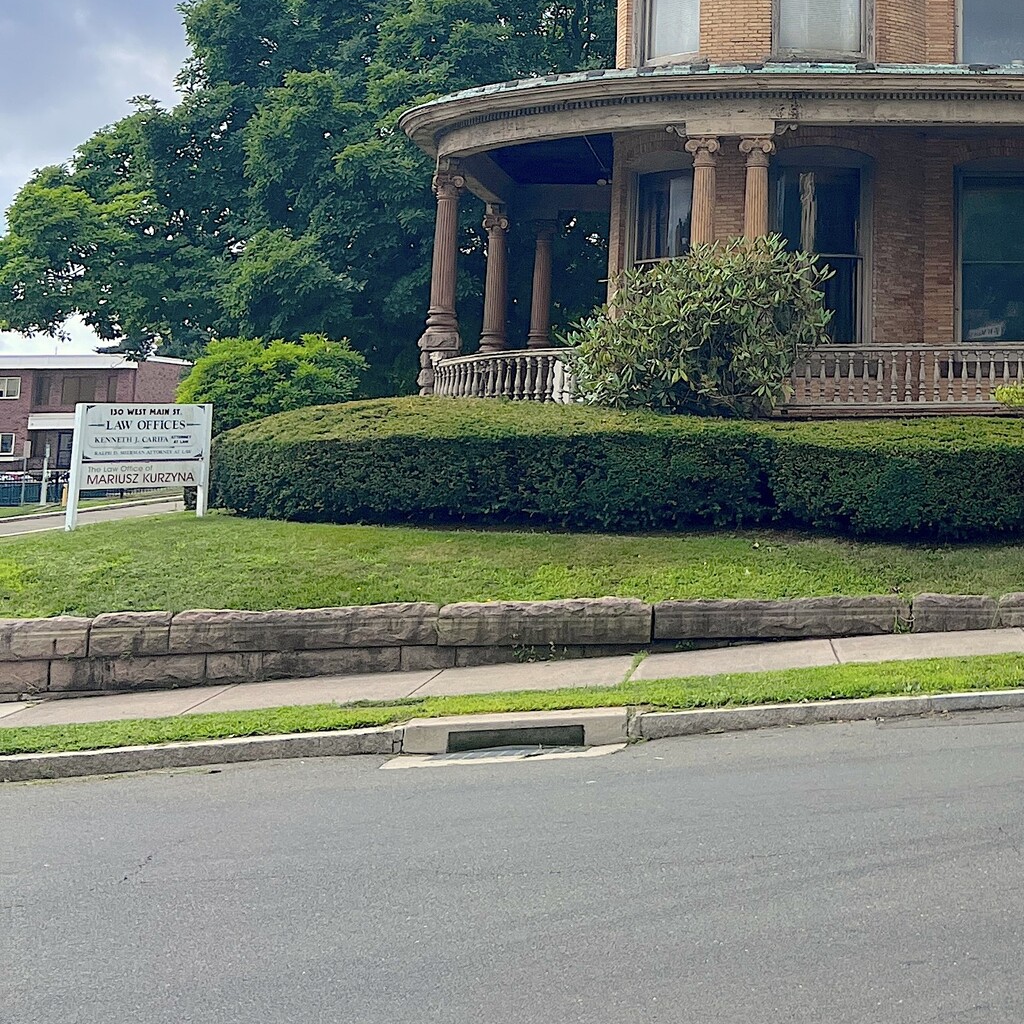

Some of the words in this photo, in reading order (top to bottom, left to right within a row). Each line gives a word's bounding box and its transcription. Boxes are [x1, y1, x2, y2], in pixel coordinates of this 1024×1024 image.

[106, 420, 132, 430] LAW
[137, 420, 186, 430] OFFICES
[86, 474, 139, 484] MARIUSZ
[142, 472, 195, 482] KURZYNA
